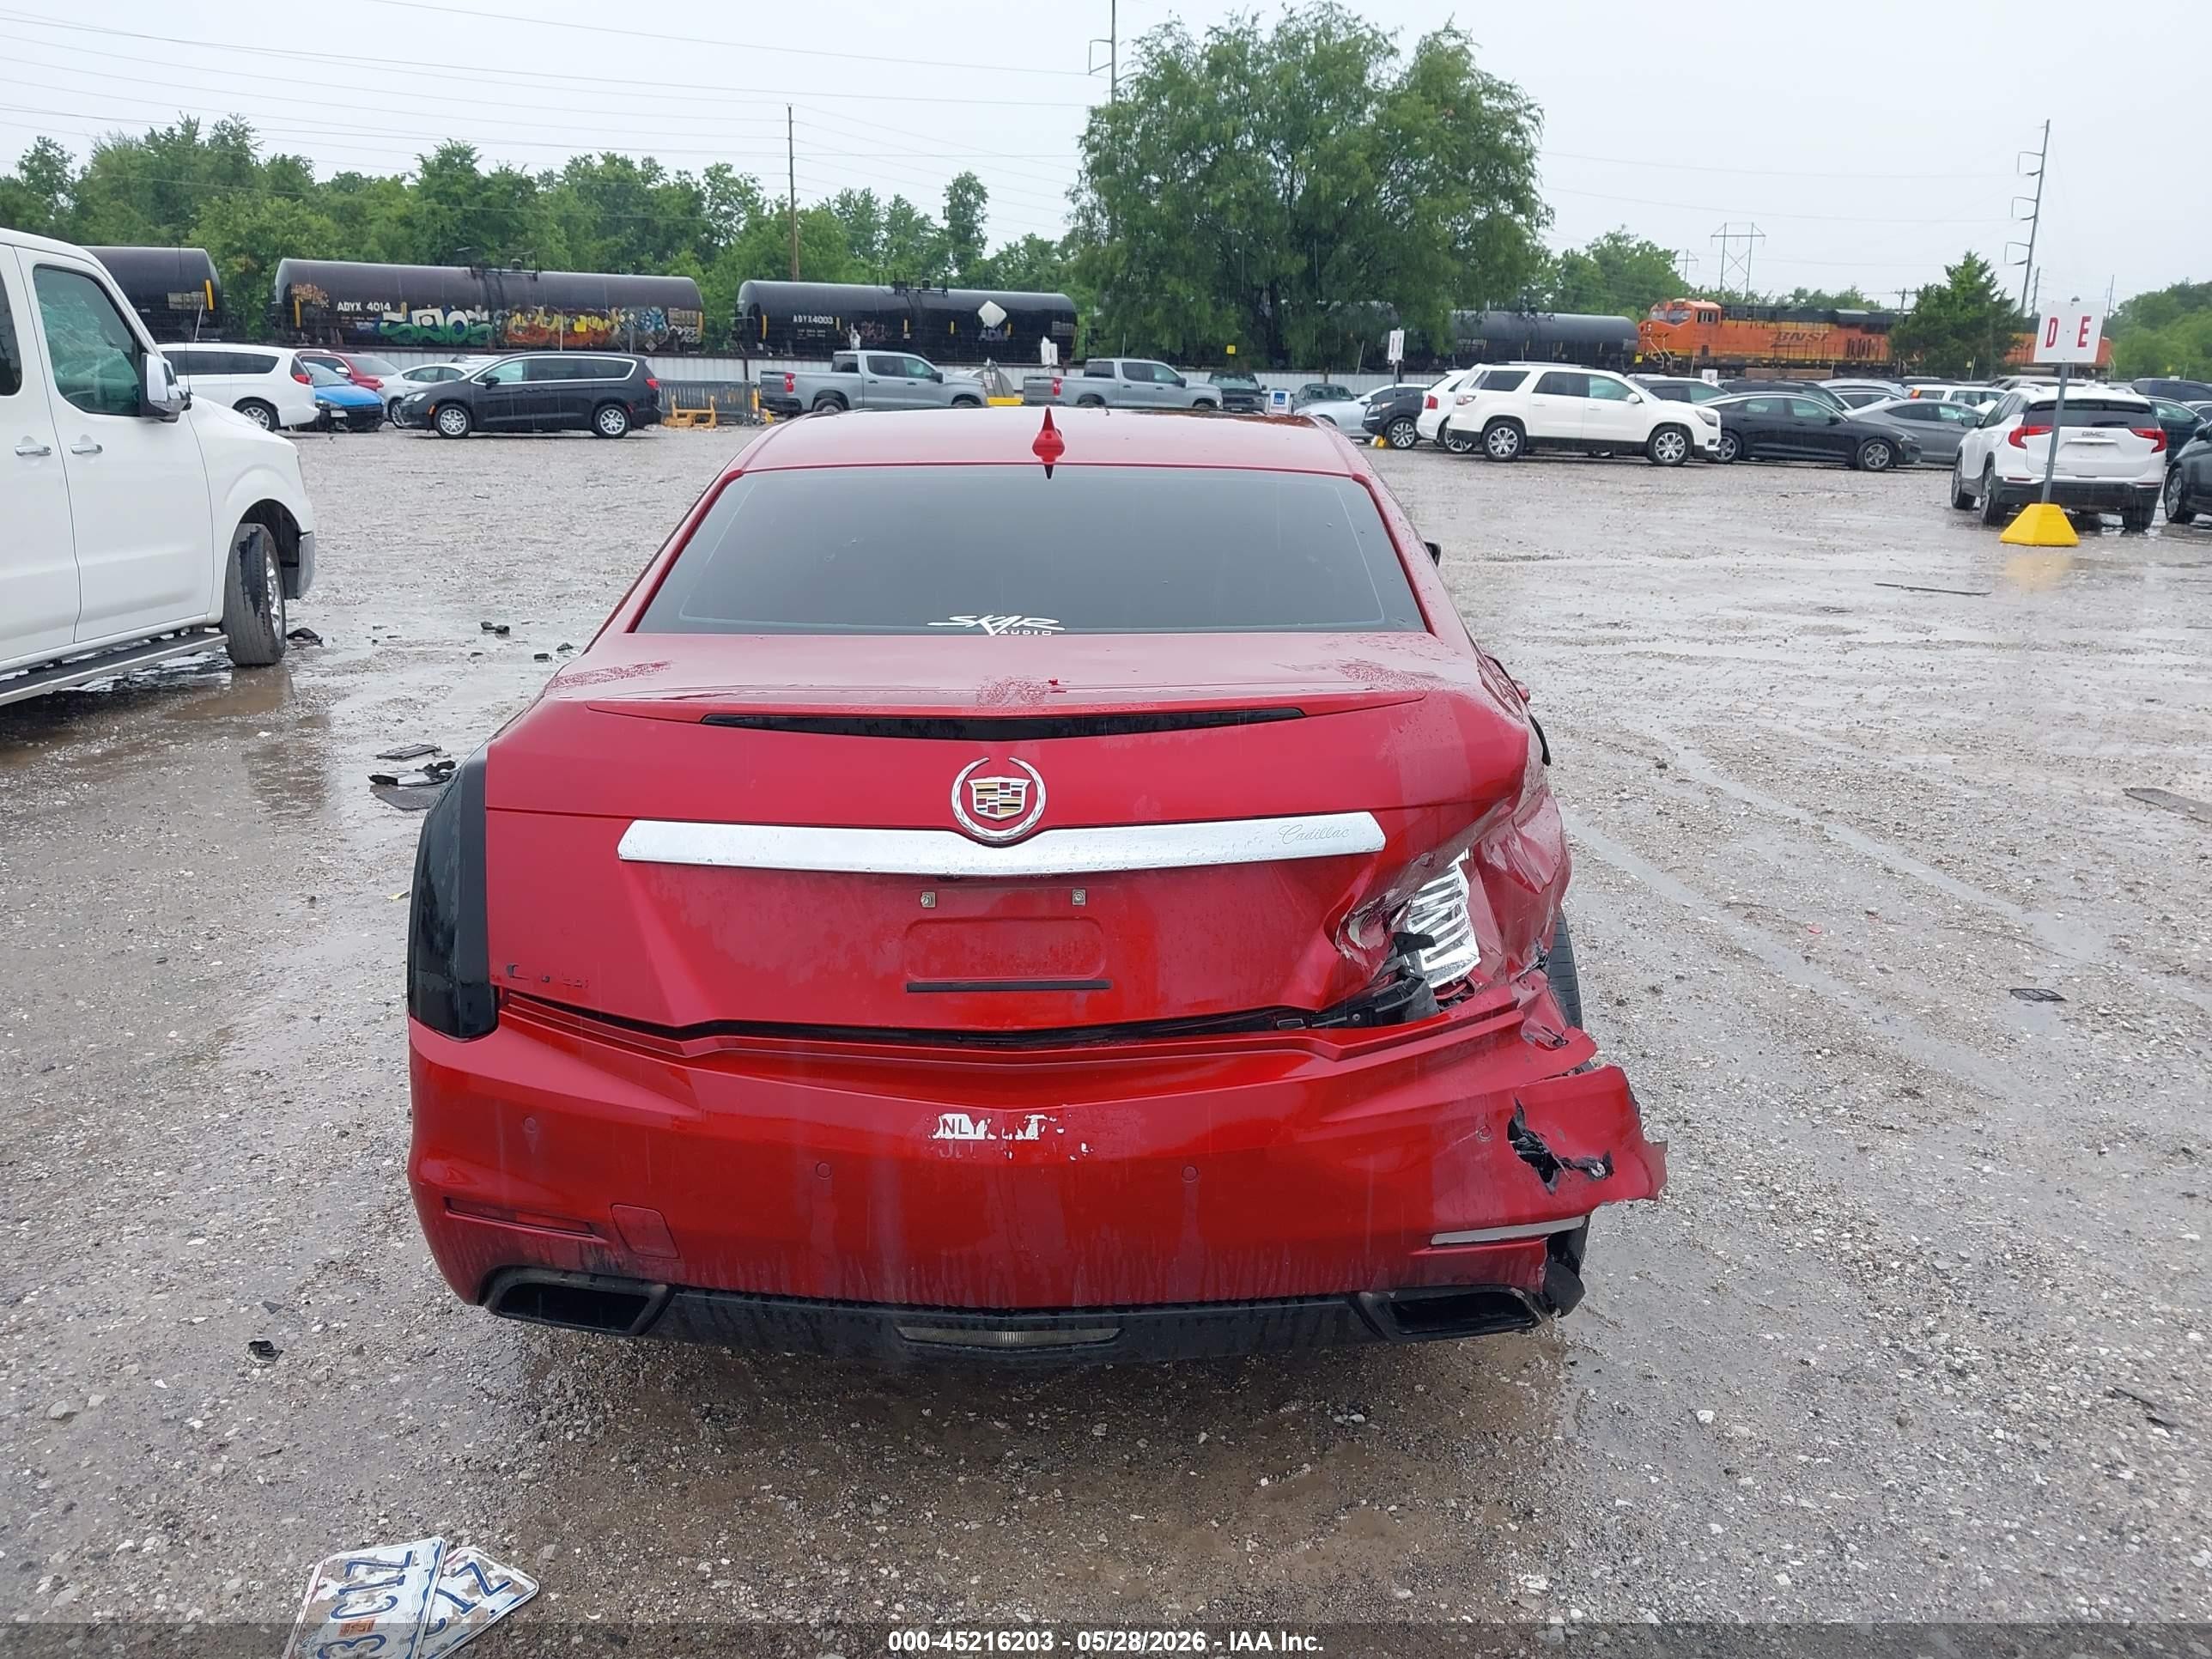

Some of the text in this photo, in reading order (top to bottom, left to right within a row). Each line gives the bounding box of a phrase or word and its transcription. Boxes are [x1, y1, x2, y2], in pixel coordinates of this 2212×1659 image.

[337, 301, 392, 312] ADYX 4014
[2045, 315, 2092, 349] D E
[1277, 823, 1350, 845] Cadillac
